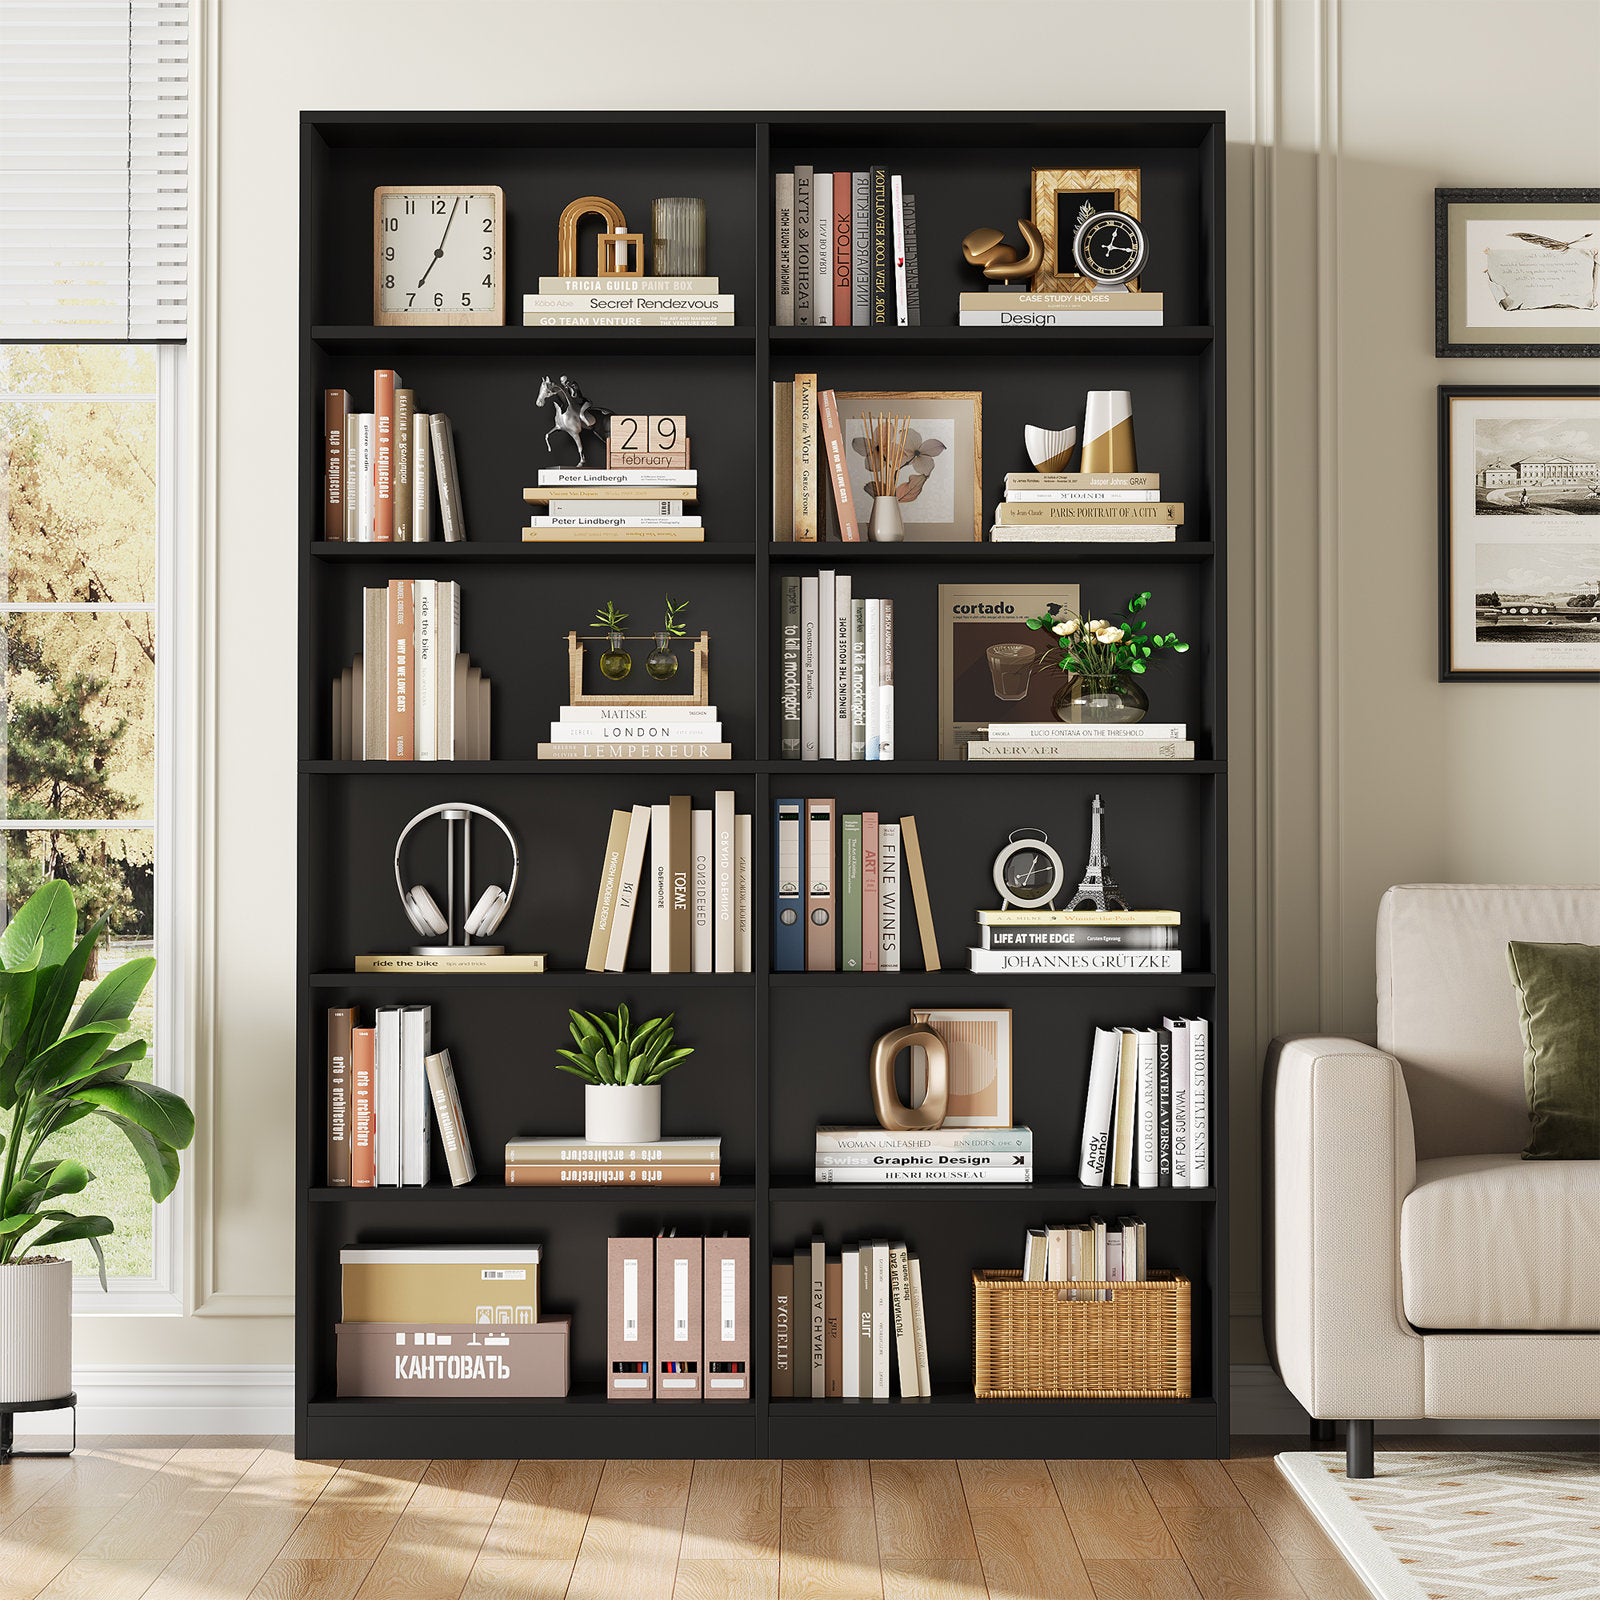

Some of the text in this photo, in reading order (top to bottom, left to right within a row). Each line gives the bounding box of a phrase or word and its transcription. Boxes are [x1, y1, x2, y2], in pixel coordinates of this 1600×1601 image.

[406, 201, 414, 214] 11
[432, 201, 446, 214] 12
[386, 218, 398, 232] 10
[482, 219, 492, 232] 2
[386, 247, 395, 261] 9
[482, 247, 492, 260] 3
[386, 275, 395, 288] 8
[482, 274, 492, 288] 4
[566, 281, 693, 291] TRICIA GUILD PAINT BOX
[406, 293, 416, 307] 7
[434, 293, 443, 307] 6
[461, 293, 471, 307] 5
[590, 298, 718, 309] Secret Rendezvous
[540, 317, 641, 325] GO TEAM VENTURE
[1001, 312, 1056, 326] Design
[802, 380, 811, 420] TAMING
[802, 435, 811, 464] WOLF
[622, 453, 672, 468] february
[1050, 508, 1158, 518] PARIS: PORTRAIT OF A CITY
[578, 518, 626, 526] Lindbergh
[953, 602, 1014, 615] cortado
[785, 625, 798, 636] to
[785, 637, 800, 650] kill
[397, 639, 406, 713] WHY DO WE LOVE CATS
[782, 662, 800, 720] mockingbird
[601, 710, 647, 719] MATISSE
[603, 728, 670, 737] LONDON
[583, 745, 709, 757] LEMPEREUR
[865, 850, 876, 874] ART
[883, 845, 896, 883] FINE
[883, 892, 896, 951] WINES
[994, 934, 1014, 944] LIFE
[1016, 934, 1027, 944] AT
[1029, 934, 1048, 944] THE
[1050, 934, 1075, 944] EDGE
[1001, 954, 1171, 969] JOHANNES GRÜTZKE
[333, 1056, 344, 1074] arts
[1195, 1034, 1205, 1088] STORIES
[357, 1071, 370, 1087] arts
[332, 1088, 346, 1141] architecture
[1160, 1044, 1169, 1175] DONATELLA VERSACE
[1195, 1090, 1205, 1131] STYLE
[357, 1100, 370, 1146] architecture
[1176, 1090, 1186, 1177] ART FOR SURVIVAL
[1087, 1136, 1100, 1168] Andy
[1095, 1132, 1108, 1174] Warhol
[823, 1156, 990, 1165] Swiss Graphic Design
[561, 1170, 662, 1182] arts & architecture
[396, 1355, 510, 1379] КАНТОВАТЬ
